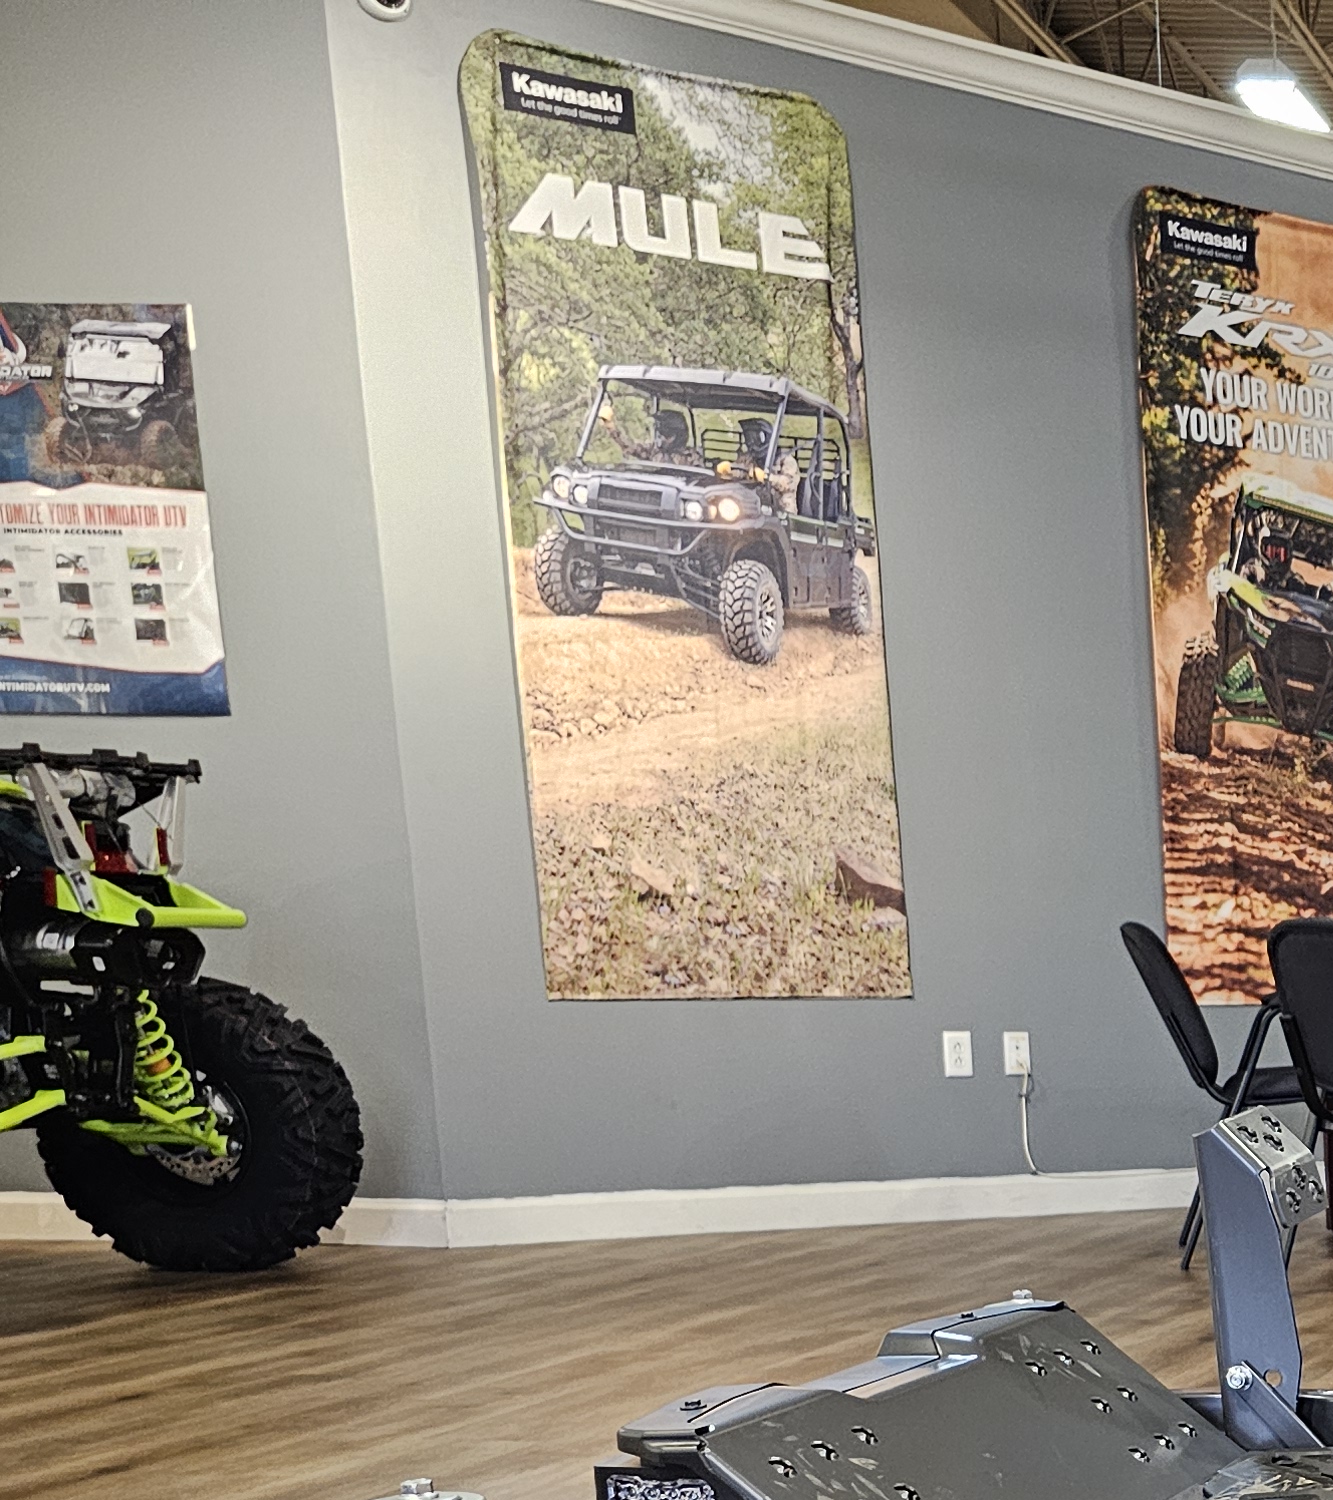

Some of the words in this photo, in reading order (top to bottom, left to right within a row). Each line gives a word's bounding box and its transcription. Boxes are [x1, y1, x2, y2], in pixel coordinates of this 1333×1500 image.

[511, 71, 623, 113] Kawasaki
[536, 100, 553, 113] the
[553, 105, 578, 118] good
[509, 173, 833, 282] MULE
[1167, 220, 1248, 252] Kawasaki
[1173, 241, 1183, 250] Let
[1184, 243, 1196, 252] the
[1196, 247, 1214, 257] good
[1214, 250, 1232, 260] times
[1199, 367, 1269, 412] YOUR
[1173, 404, 1244, 449] YOUR
[0, 503, 44, 525] TOMIZE
[49, 503, 80, 525] YOUR
[83, 504, 160, 528] INTIMIDATOR
[163, 505, 187, 529] UTV
[3, 527, 61, 537] INTIMIDATOR
[64, 529, 123, 537] ACCESSORIES
[0, 681, 110, 693] NTIMIDATORUTV.COM
